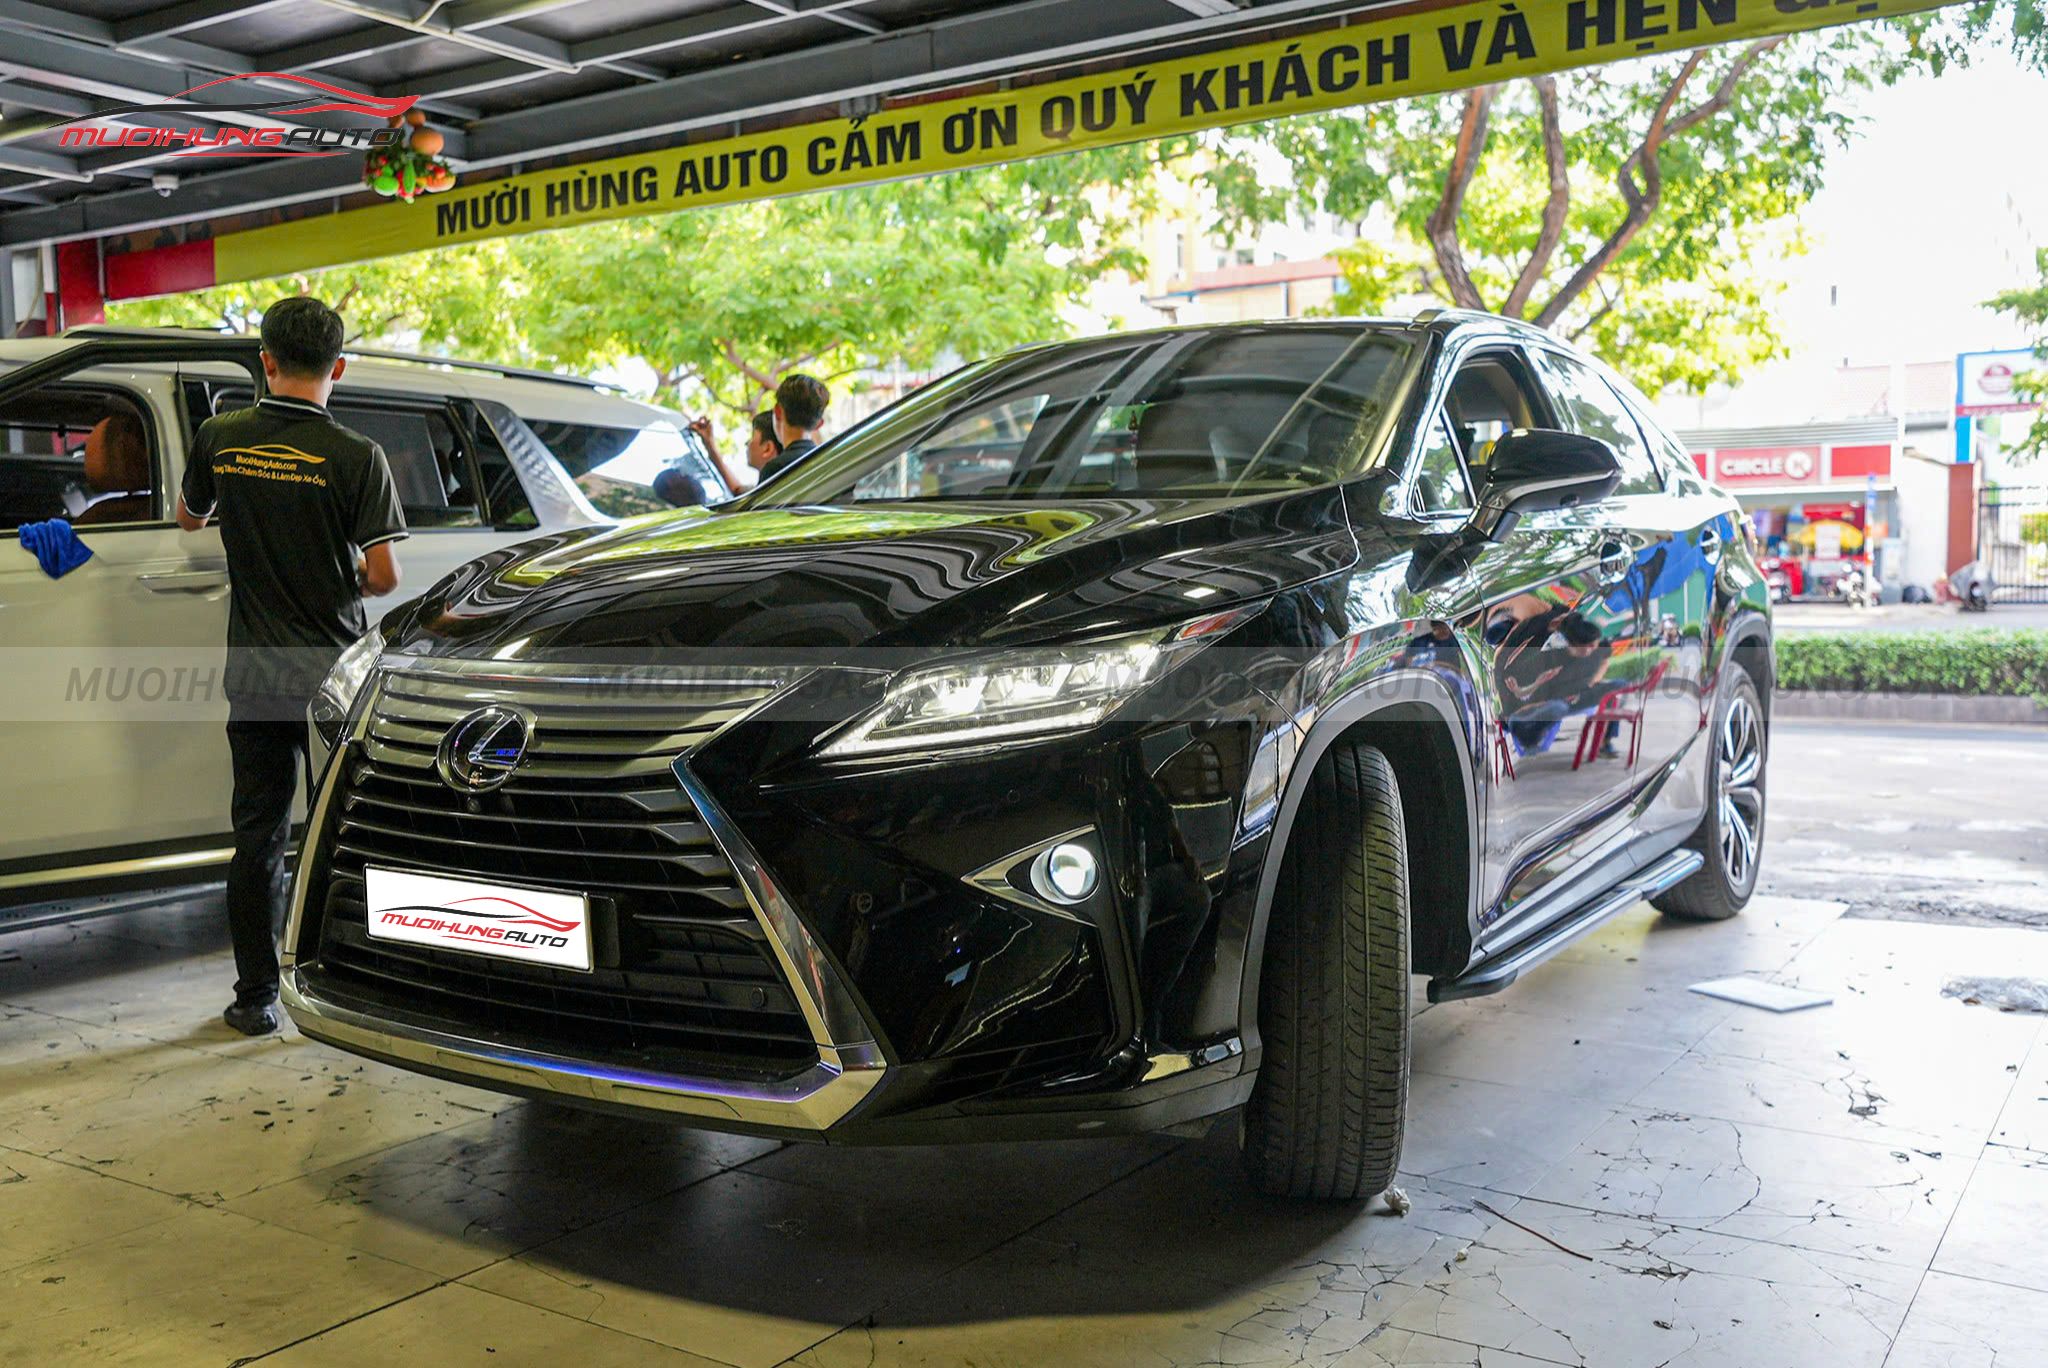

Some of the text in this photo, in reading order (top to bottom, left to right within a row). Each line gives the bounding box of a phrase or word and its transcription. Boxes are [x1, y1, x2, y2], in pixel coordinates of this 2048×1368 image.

[436, 0, 1736, 237] MƯỜI HÙNG AUTO CẢM ƠN QUÝ KHÁCH VÀ HẸN
[1720, 456, 1783, 477] CIRCLE
